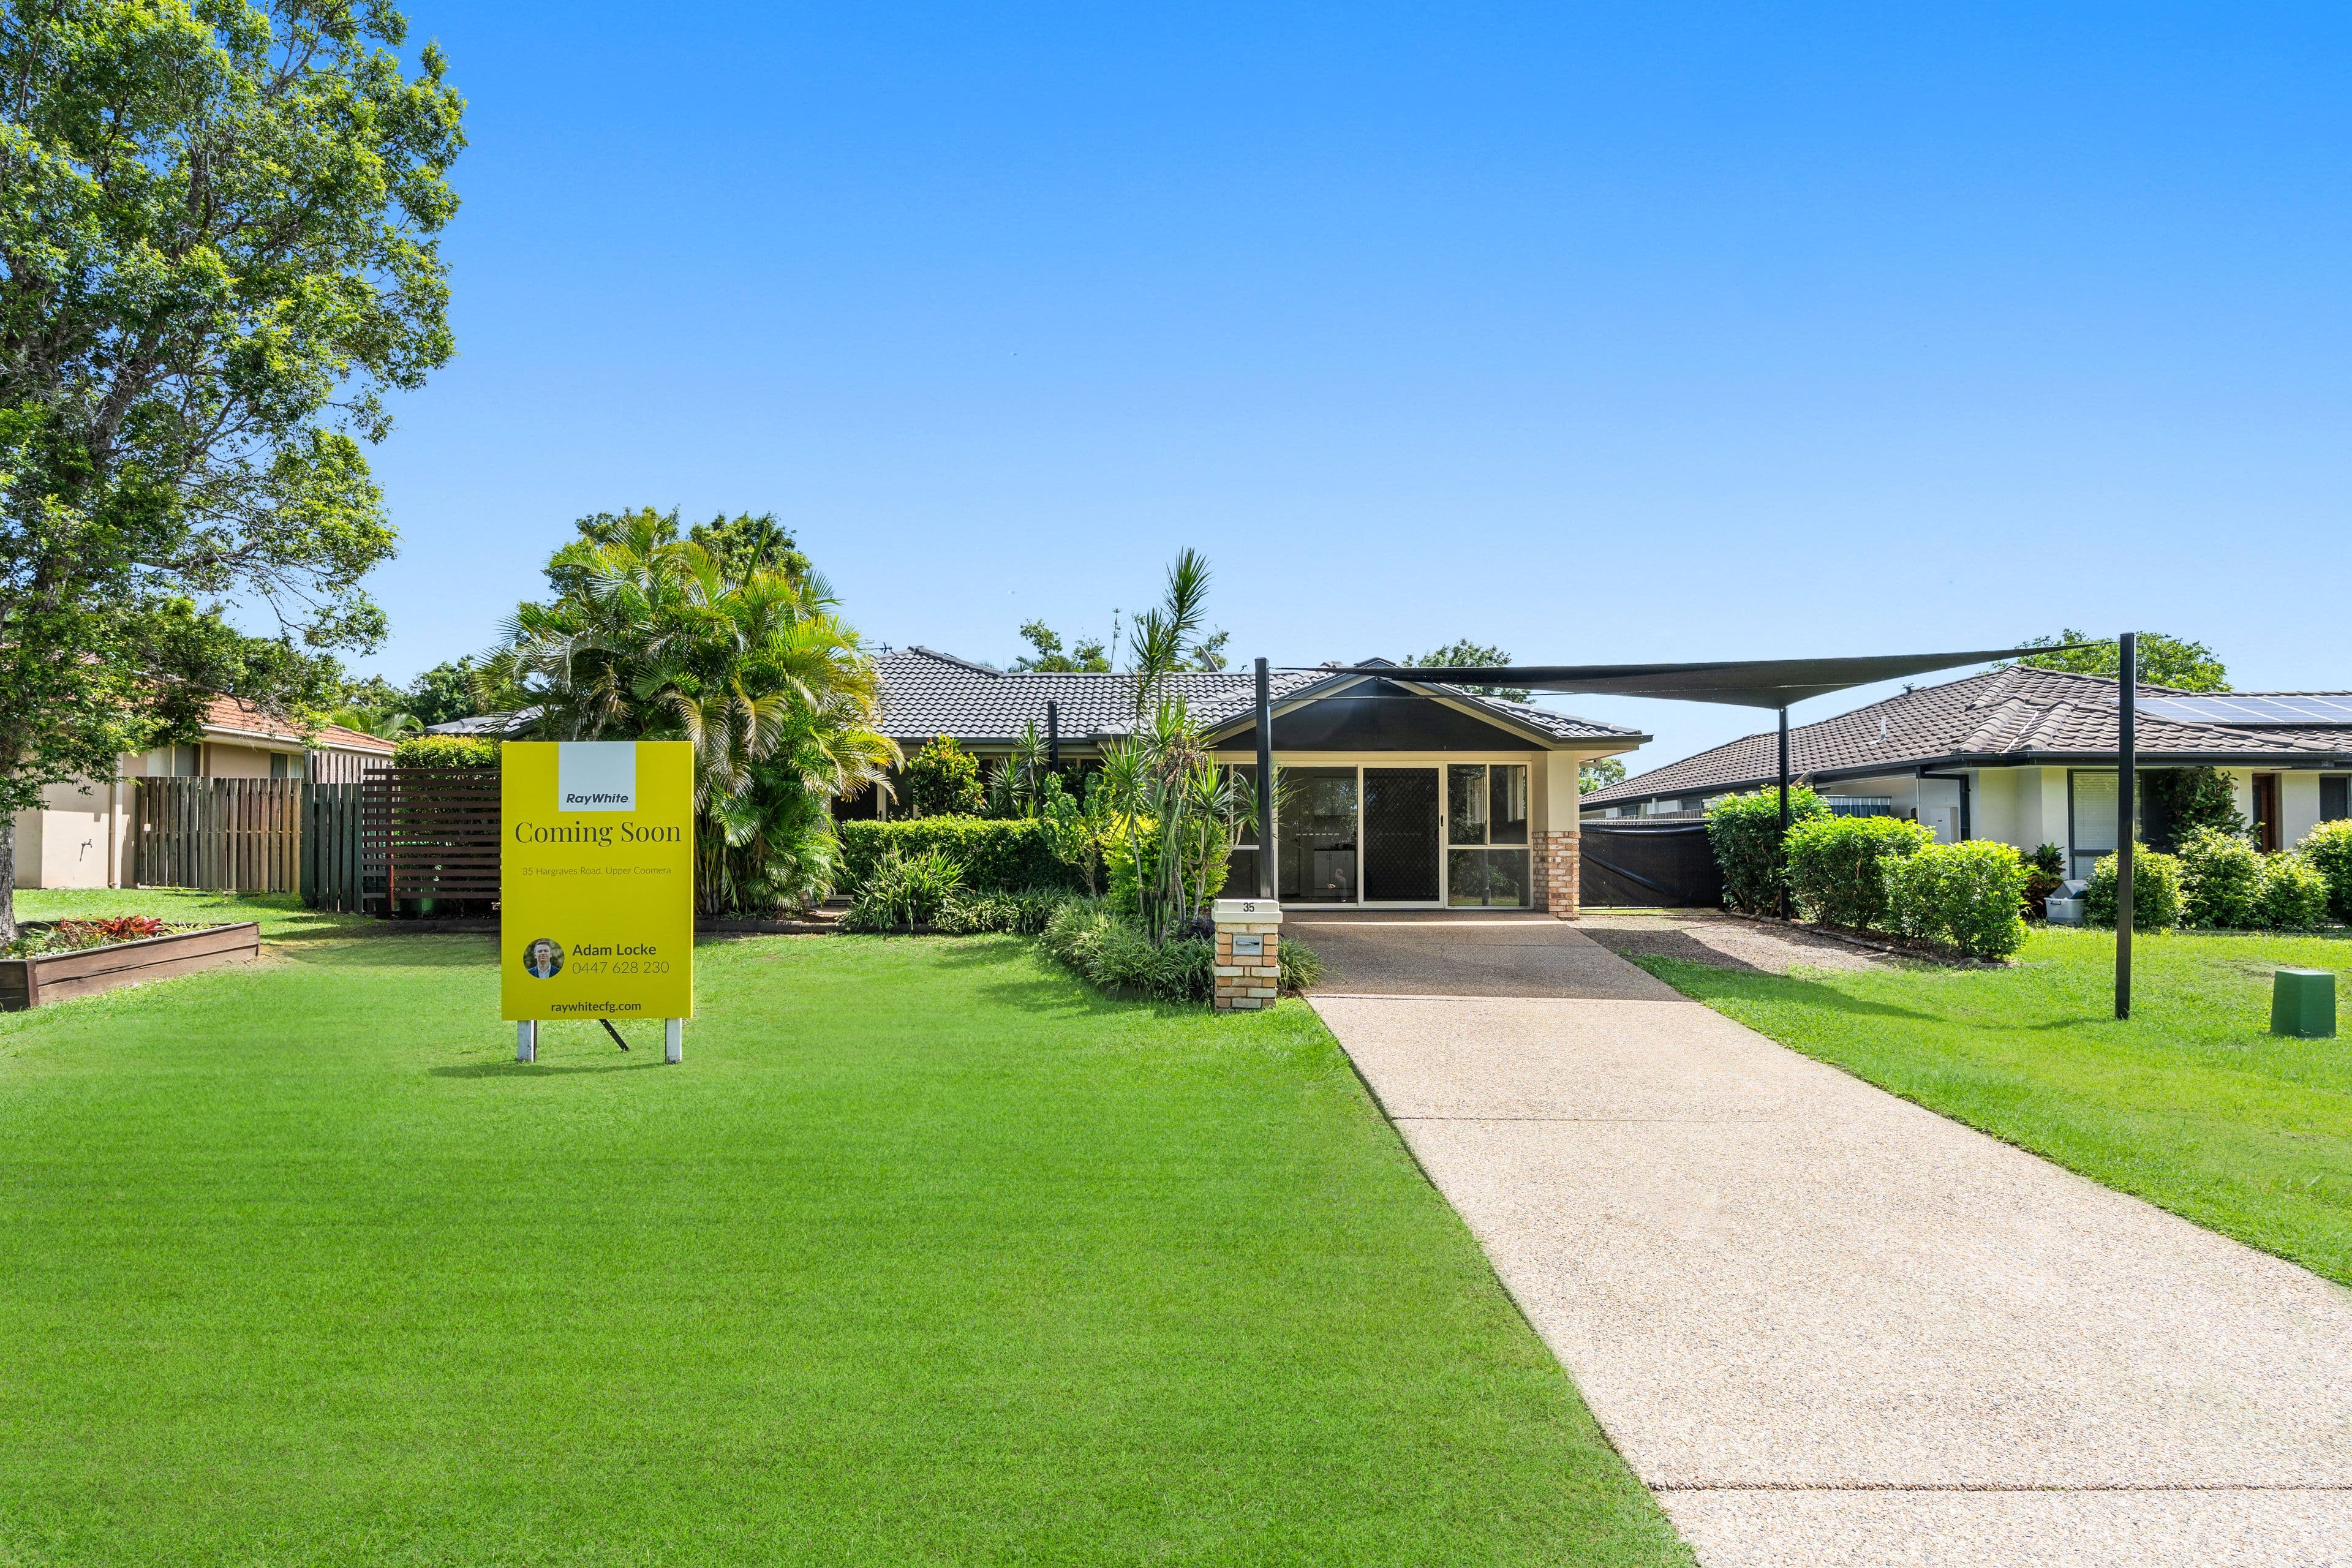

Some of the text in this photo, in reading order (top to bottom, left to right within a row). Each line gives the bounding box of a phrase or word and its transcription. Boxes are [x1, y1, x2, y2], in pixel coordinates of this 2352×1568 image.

[515, 820, 682, 847] Coming Soon
[522, 867, 533, 876] 35
[536, 867, 578, 877] Hargraves
[606, 867, 631, 878] Upper
[633, 866, 671, 875] Coomera
[1243, 902, 1255, 913] 35
[572, 943, 657, 956] Adam Locke
[572, 960, 669, 974] 0447 628 230
[551, 1000, 641, 1014] raywhitecfg.com
